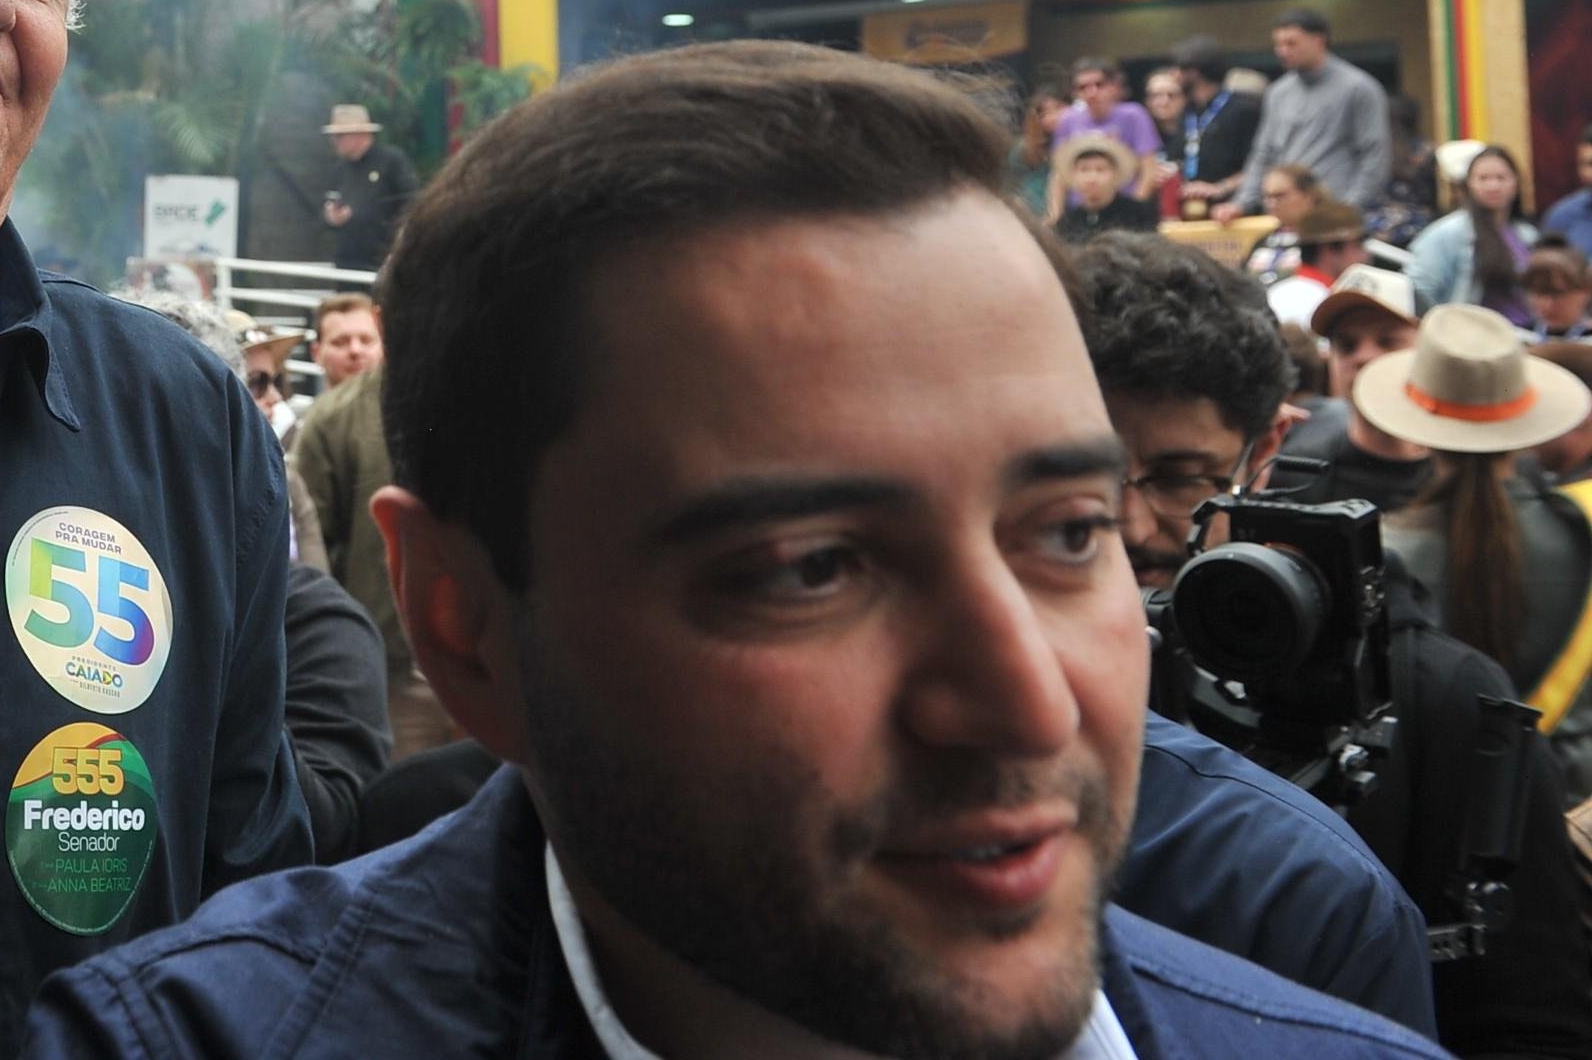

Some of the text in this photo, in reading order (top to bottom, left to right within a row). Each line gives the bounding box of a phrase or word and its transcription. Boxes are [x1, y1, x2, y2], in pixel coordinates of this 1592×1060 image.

[55, 530, 122, 555] PRA MUDAR
[58, 522, 116, 544] CORAGEM
[24, 537, 156, 666] 55
[65, 662, 123, 688] CAIADO
[51, 746, 125, 796] 555
[24, 800, 146, 831] Frederico
[58, 832, 120, 852] Senador
[55, 858, 100, 873] PAULA
[47, 878, 88, 893] ANNA
